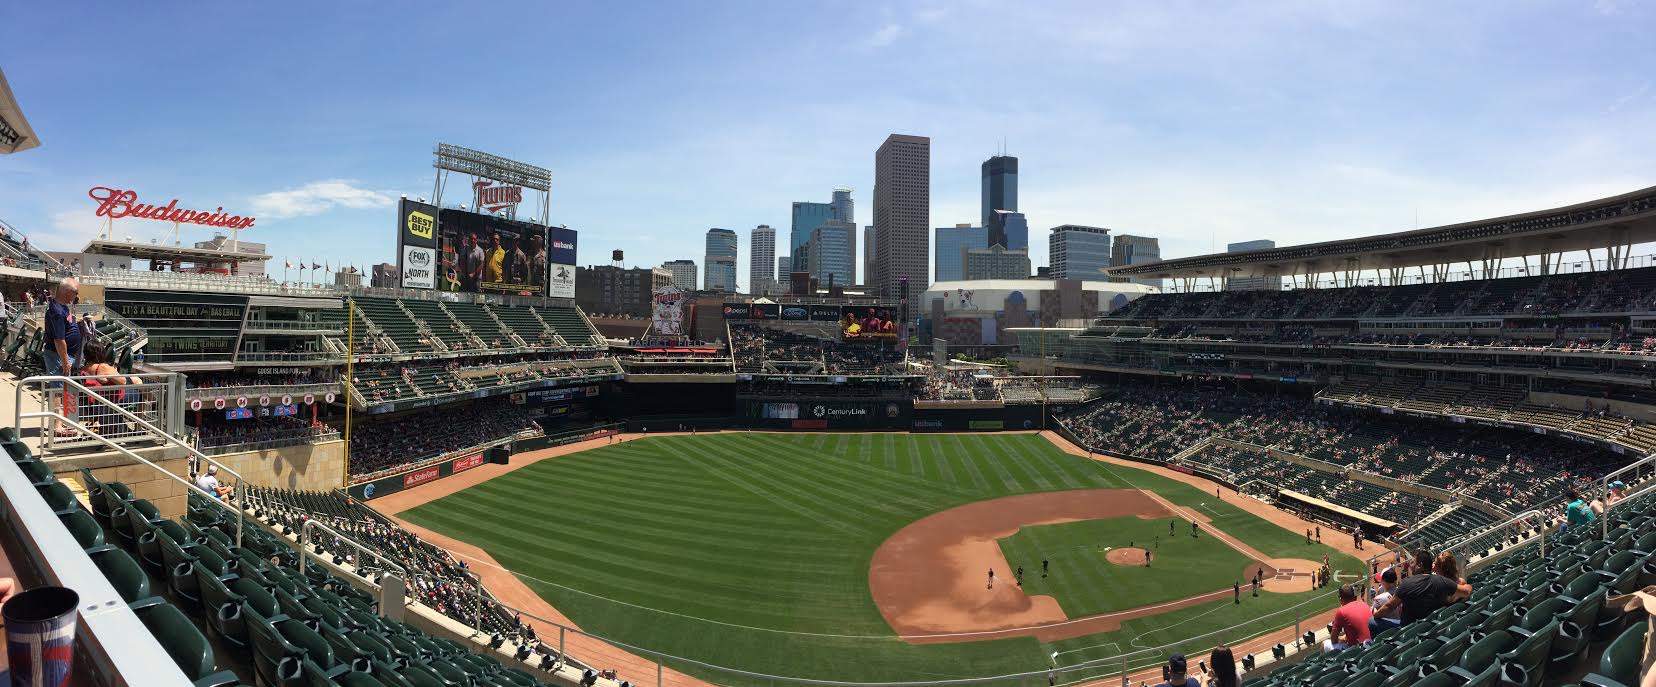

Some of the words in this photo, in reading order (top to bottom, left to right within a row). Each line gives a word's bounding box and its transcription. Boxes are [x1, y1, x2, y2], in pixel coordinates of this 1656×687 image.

[473, 179, 523, 209] Twins
[88, 186, 256, 229] Budweiser
[411, 214, 433, 228] BEST
[411, 223, 431, 235] BUY
[413, 251, 427, 261] FOX
[408, 268, 430, 279] NORTH
[656, 291, 682, 304] Twins
[121, 305, 138, 315] IT'S
[140, 306, 145, 315] A
[147, 306, 185, 316] BEAUTIFUL
[186, 307, 199, 316] DAY
[210, 308, 240, 317] BASEBALL
[174, 339, 198, 350] TWINS
[629, 339, 668, 347] TARGET
[678, 339, 706, 347] FIELD
[257, 367, 272, 375] GOOSE
[67, 393, 77, 414] 222
[827, 408, 866, 416] CenturyLink
